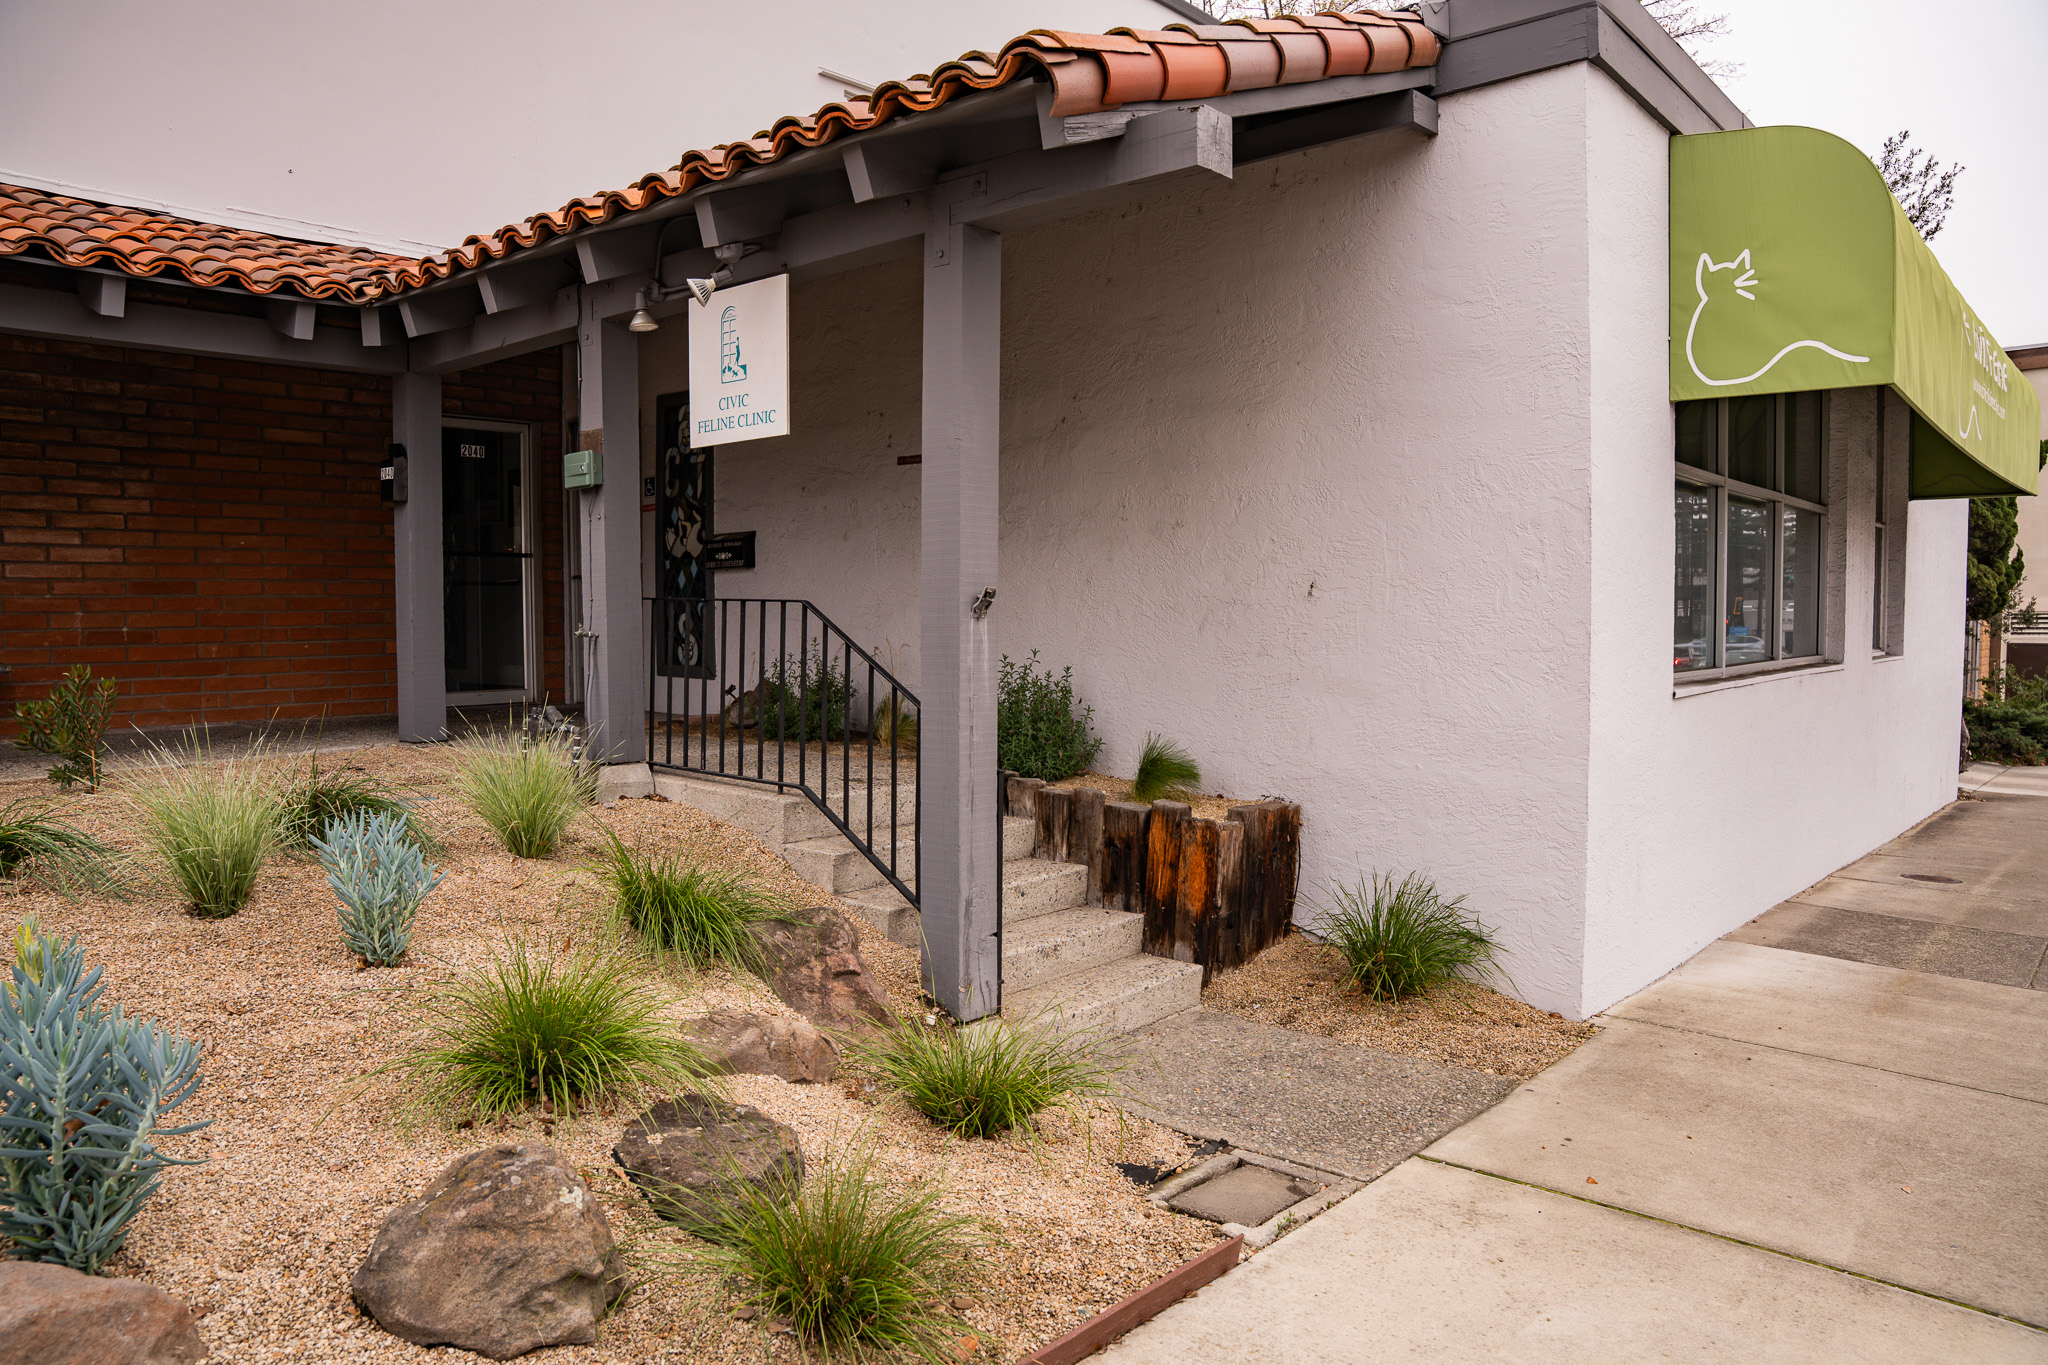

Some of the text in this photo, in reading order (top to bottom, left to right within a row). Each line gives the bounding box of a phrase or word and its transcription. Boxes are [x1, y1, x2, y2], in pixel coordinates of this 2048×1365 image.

[718, 393, 749, 411] CIVIC
[698, 409, 776, 434] FELINE CLINIC
[461, 445, 484, 458] 2040
